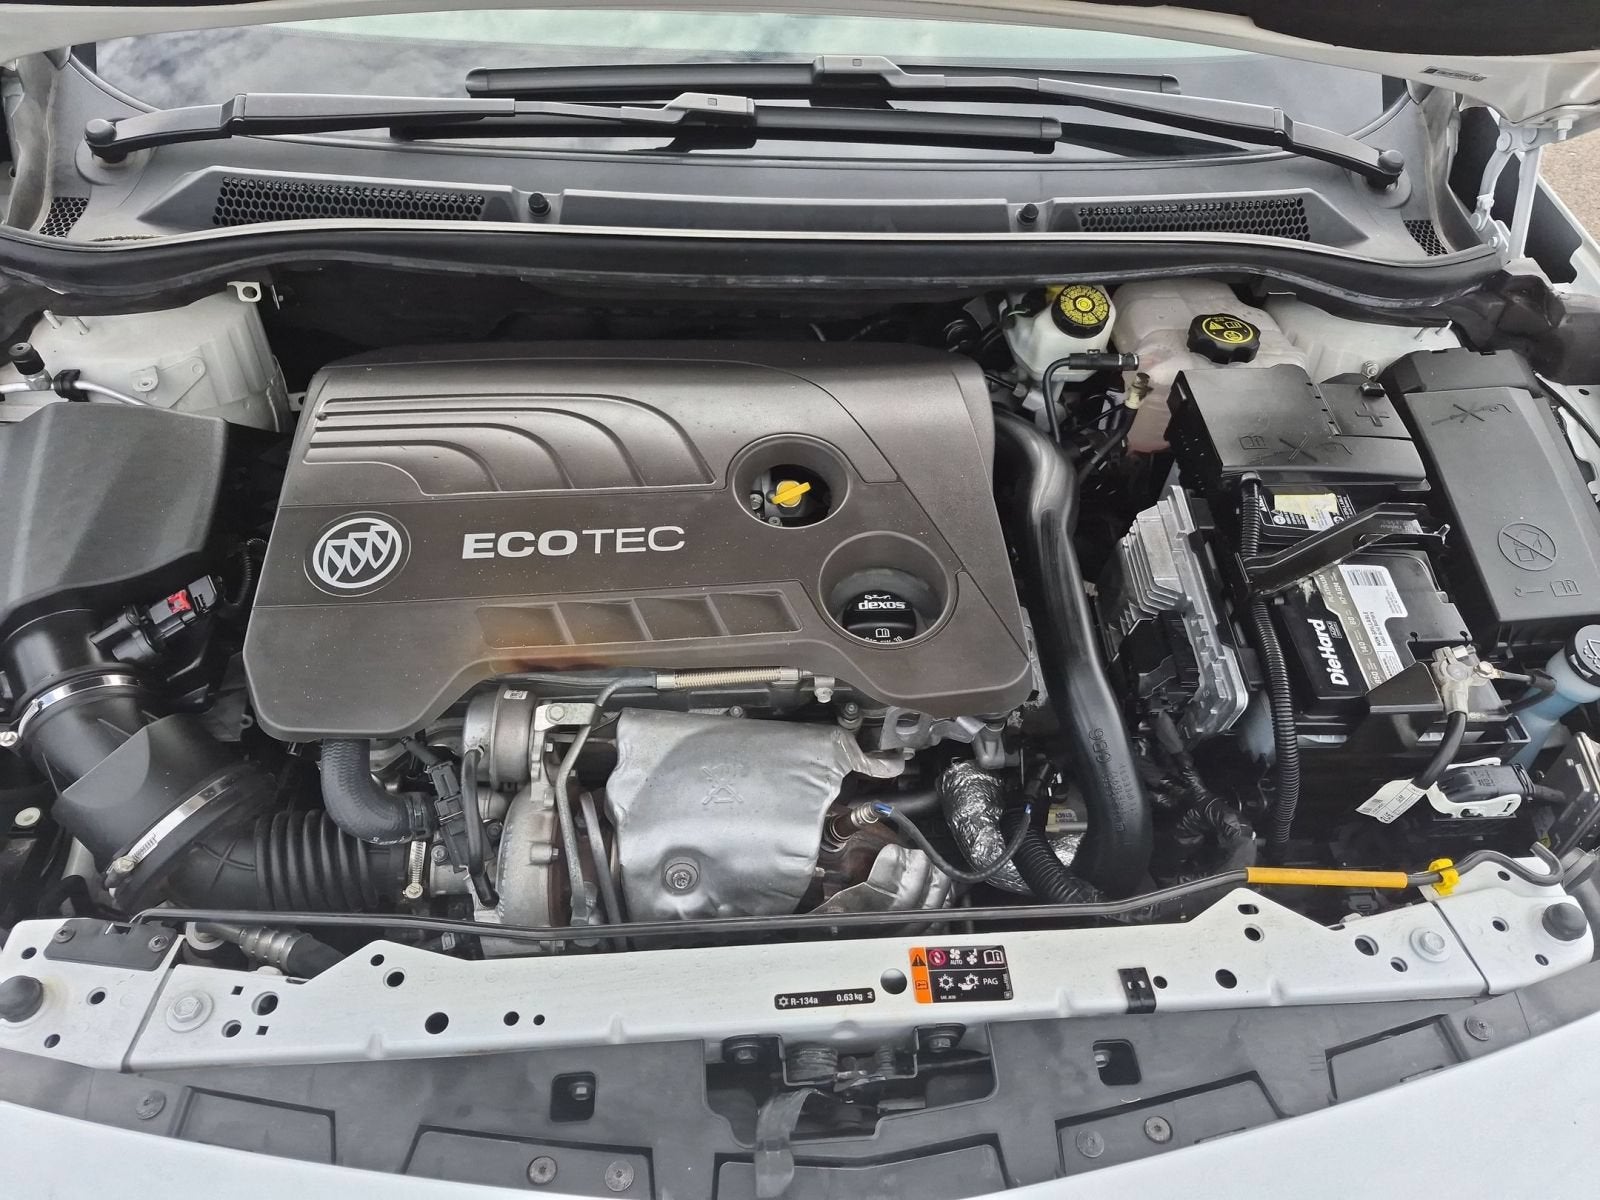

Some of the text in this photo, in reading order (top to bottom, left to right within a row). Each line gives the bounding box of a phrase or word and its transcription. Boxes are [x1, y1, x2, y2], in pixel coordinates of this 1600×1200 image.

[462, 525, 685, 559] ECOTEC
[858, 600, 906, 610] dexos
[1307, 618, 1349, 686] DieHard
[982, 977, 999, 985] PAG
[790, 993, 863, 1006] R-134a 0.63 kg
